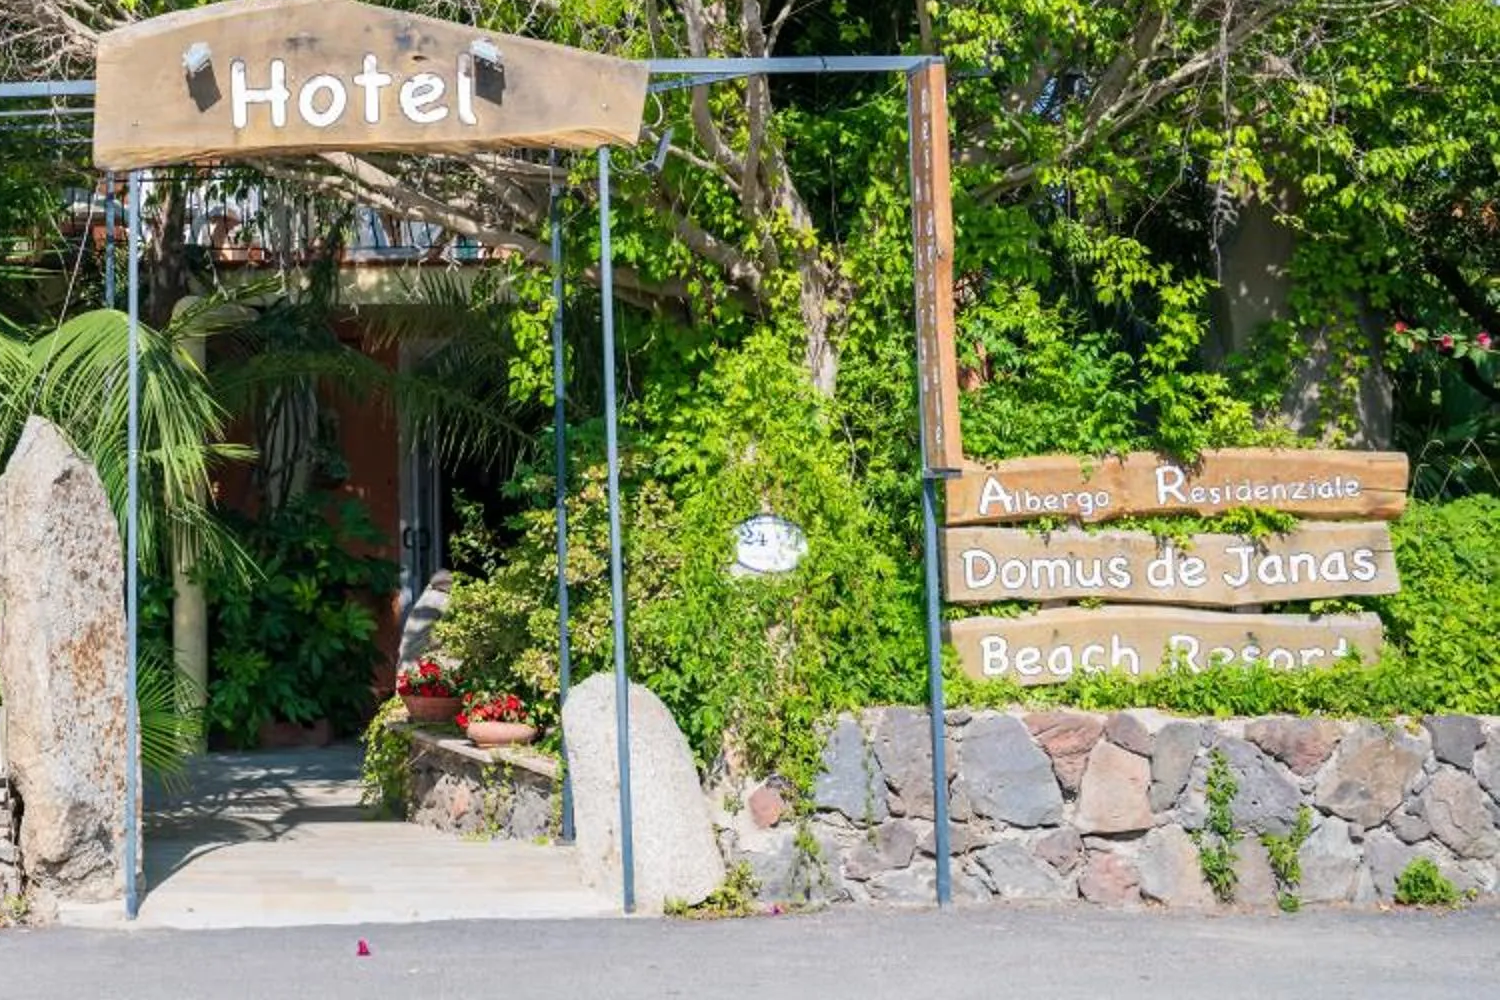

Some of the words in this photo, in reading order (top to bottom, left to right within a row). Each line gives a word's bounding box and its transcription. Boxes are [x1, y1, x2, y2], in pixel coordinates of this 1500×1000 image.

[230, 53, 477, 128] Hotel
[979, 476, 1110, 517] Albergo
[1155, 465, 1362, 504] Residenziale
[961, 549, 1130, 590] Domus
[1146, 551, 1208, 588] de
[1223, 545, 1378, 588] Janas
[980, 634, 1140, 677] Beach
